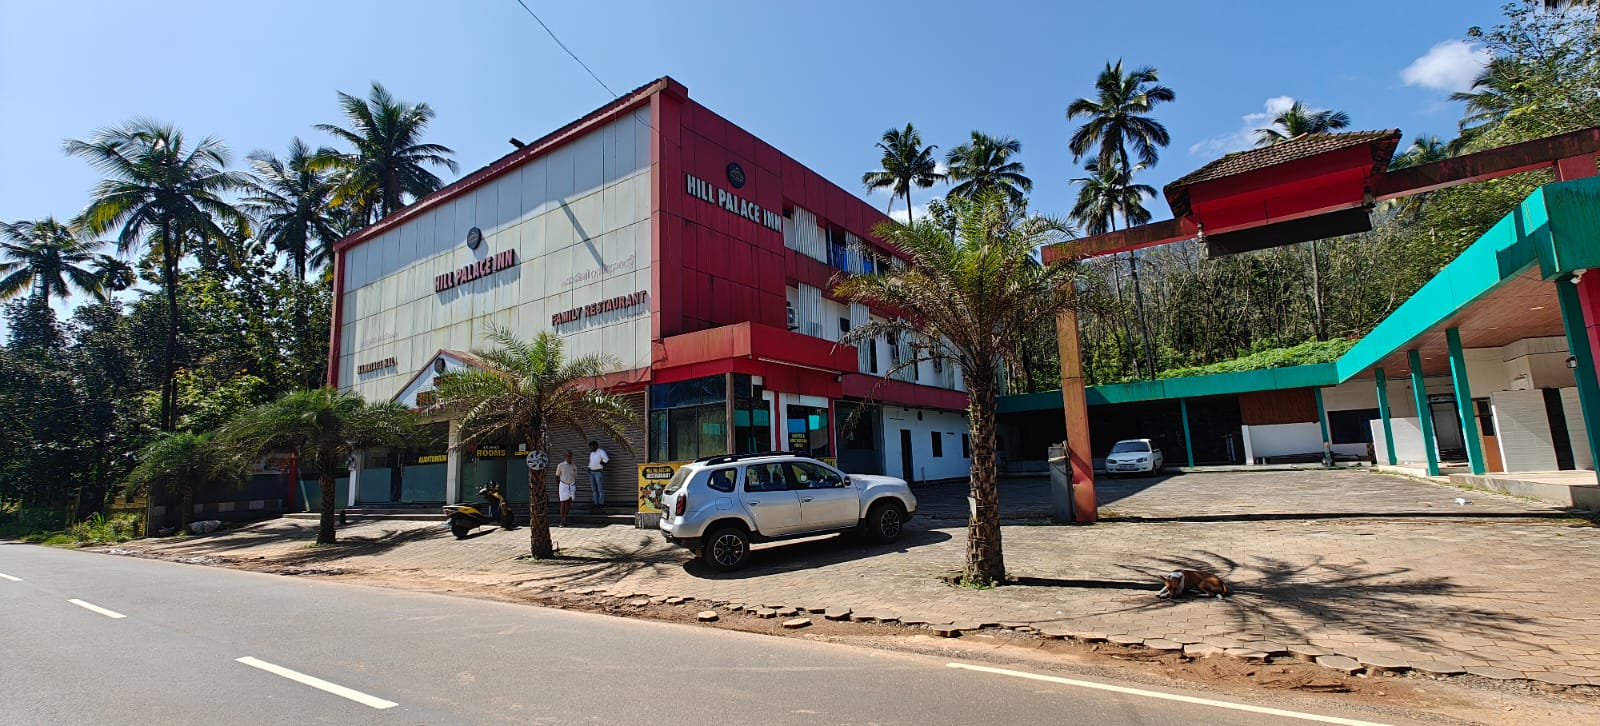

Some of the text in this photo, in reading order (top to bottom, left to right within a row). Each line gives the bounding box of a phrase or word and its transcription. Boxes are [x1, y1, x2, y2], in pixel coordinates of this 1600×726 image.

[686, 173, 782, 233] HILL PALACE INN
[434, 248, 514, 292] HILL PALACE INN
[552, 290, 647, 326] FAMILY RESTAURANT
[476, 449, 506, 457] ROOMS
